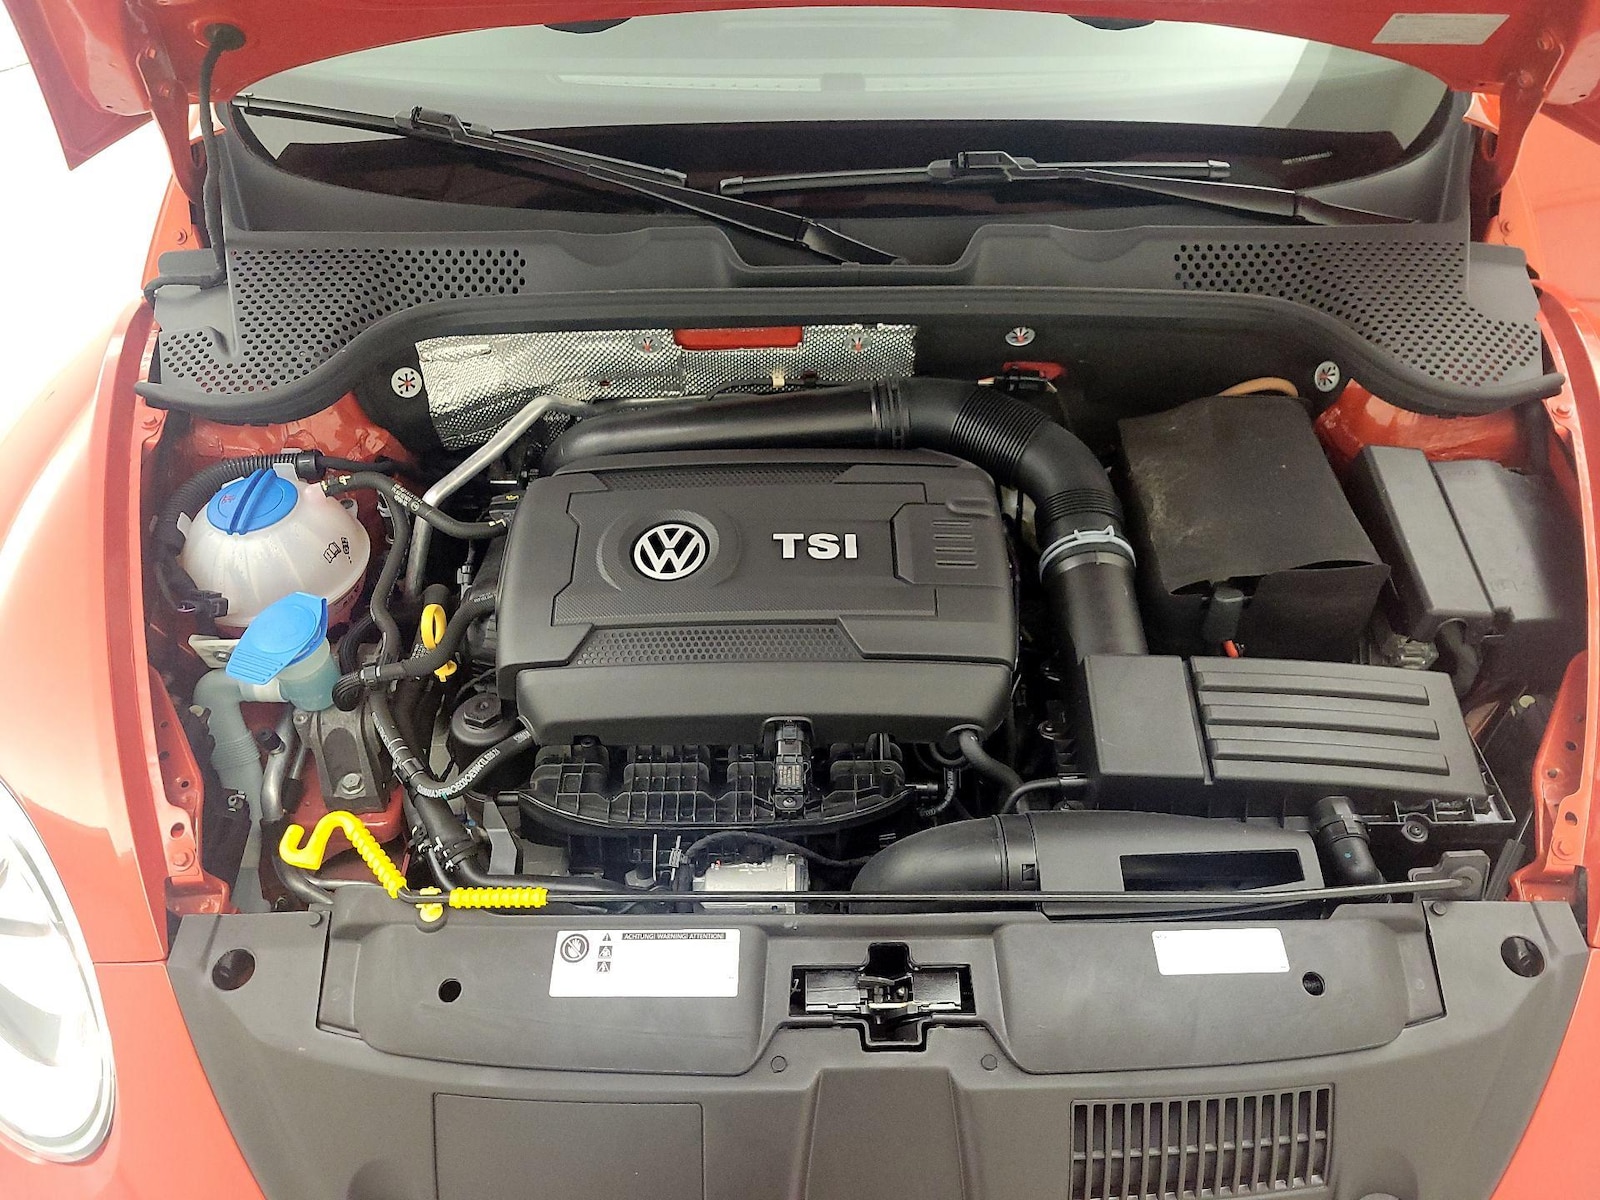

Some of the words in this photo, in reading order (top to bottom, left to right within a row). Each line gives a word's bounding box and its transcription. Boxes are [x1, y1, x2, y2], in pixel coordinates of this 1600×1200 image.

[634, 523, 706, 580] VW
[773, 533, 858, 560] TSI
[623, 932, 656, 940] ACHTUNG!
